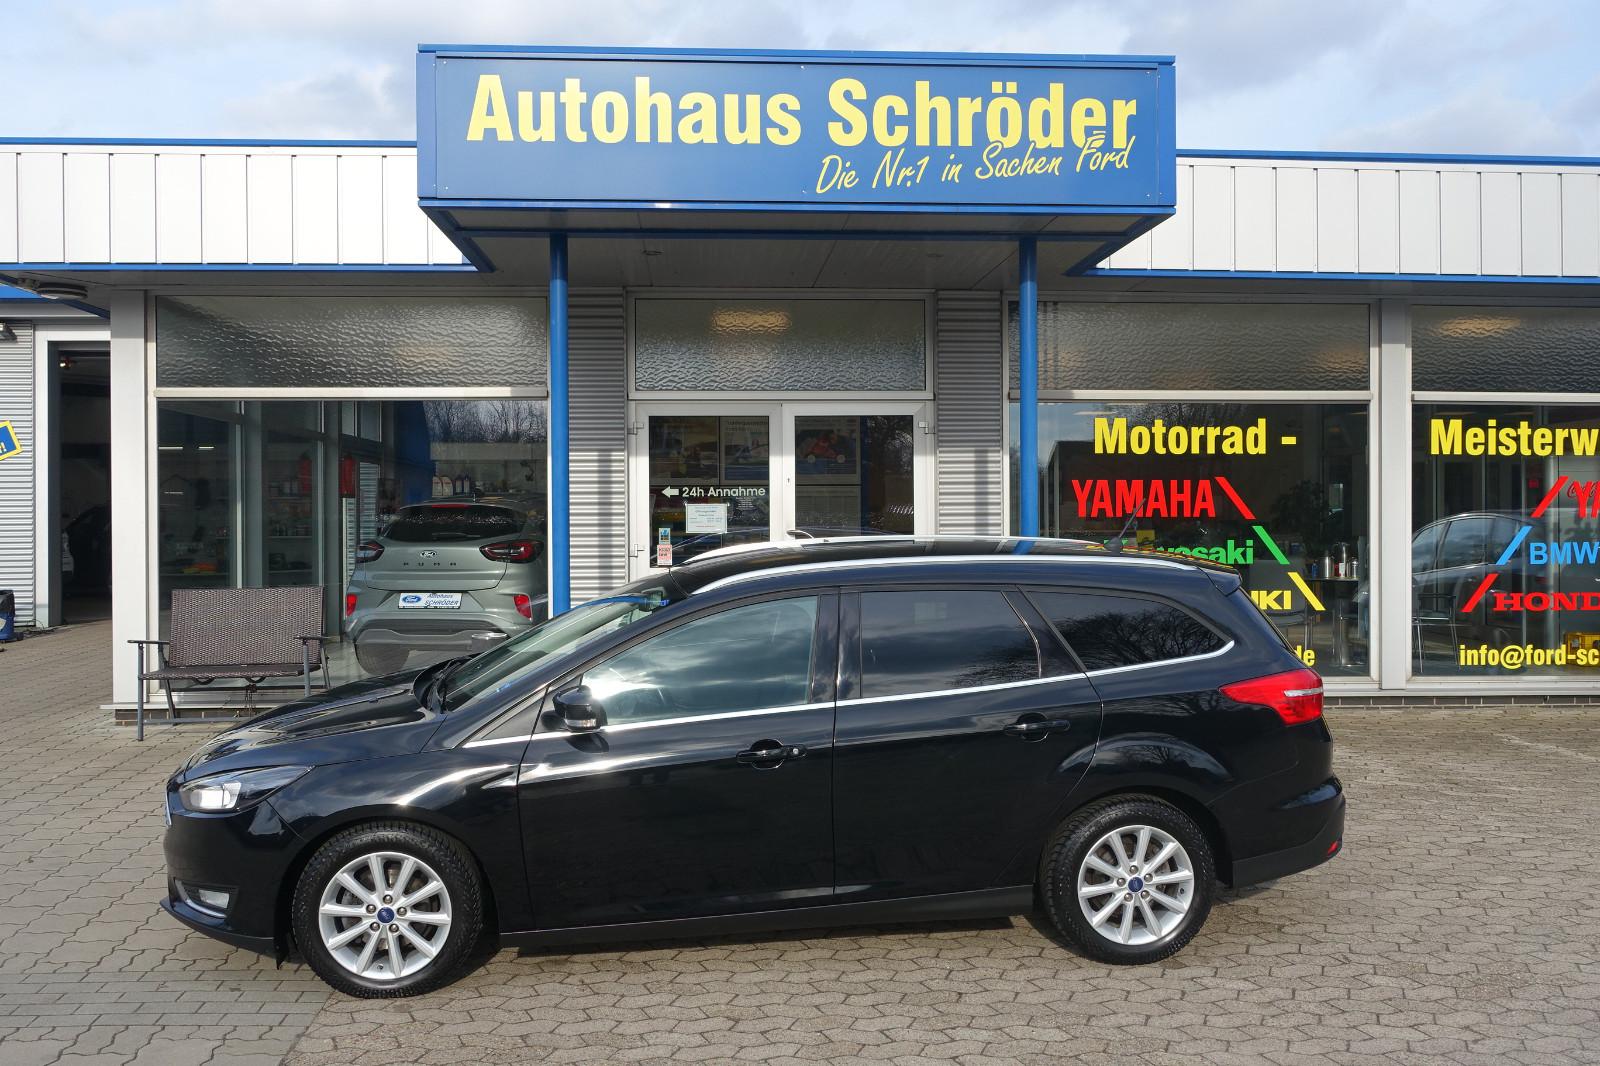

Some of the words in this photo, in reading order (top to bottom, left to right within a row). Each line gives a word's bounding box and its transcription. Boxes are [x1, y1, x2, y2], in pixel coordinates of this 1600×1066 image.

[466, 74, 802, 145] Autohaus
[828, 78, 1138, 149] Schröder
[816, 154, 859, 194] Die
[872, 148, 930, 189] Nr.1
[941, 153, 963, 183] in
[975, 141, 1063, 180] Sachen
[1076, 130, 1137, 173] Ford
[1094, 417, 1267, 455] Motorrad
[1430, 418, 1600, 457] Meisterw
[682, 486, 704, 497] 24h
[708, 486, 766, 497] Annahme
[1072, 479, 1216, 518] YAMAHA
[1529, 542, 1600, 565] BMW
